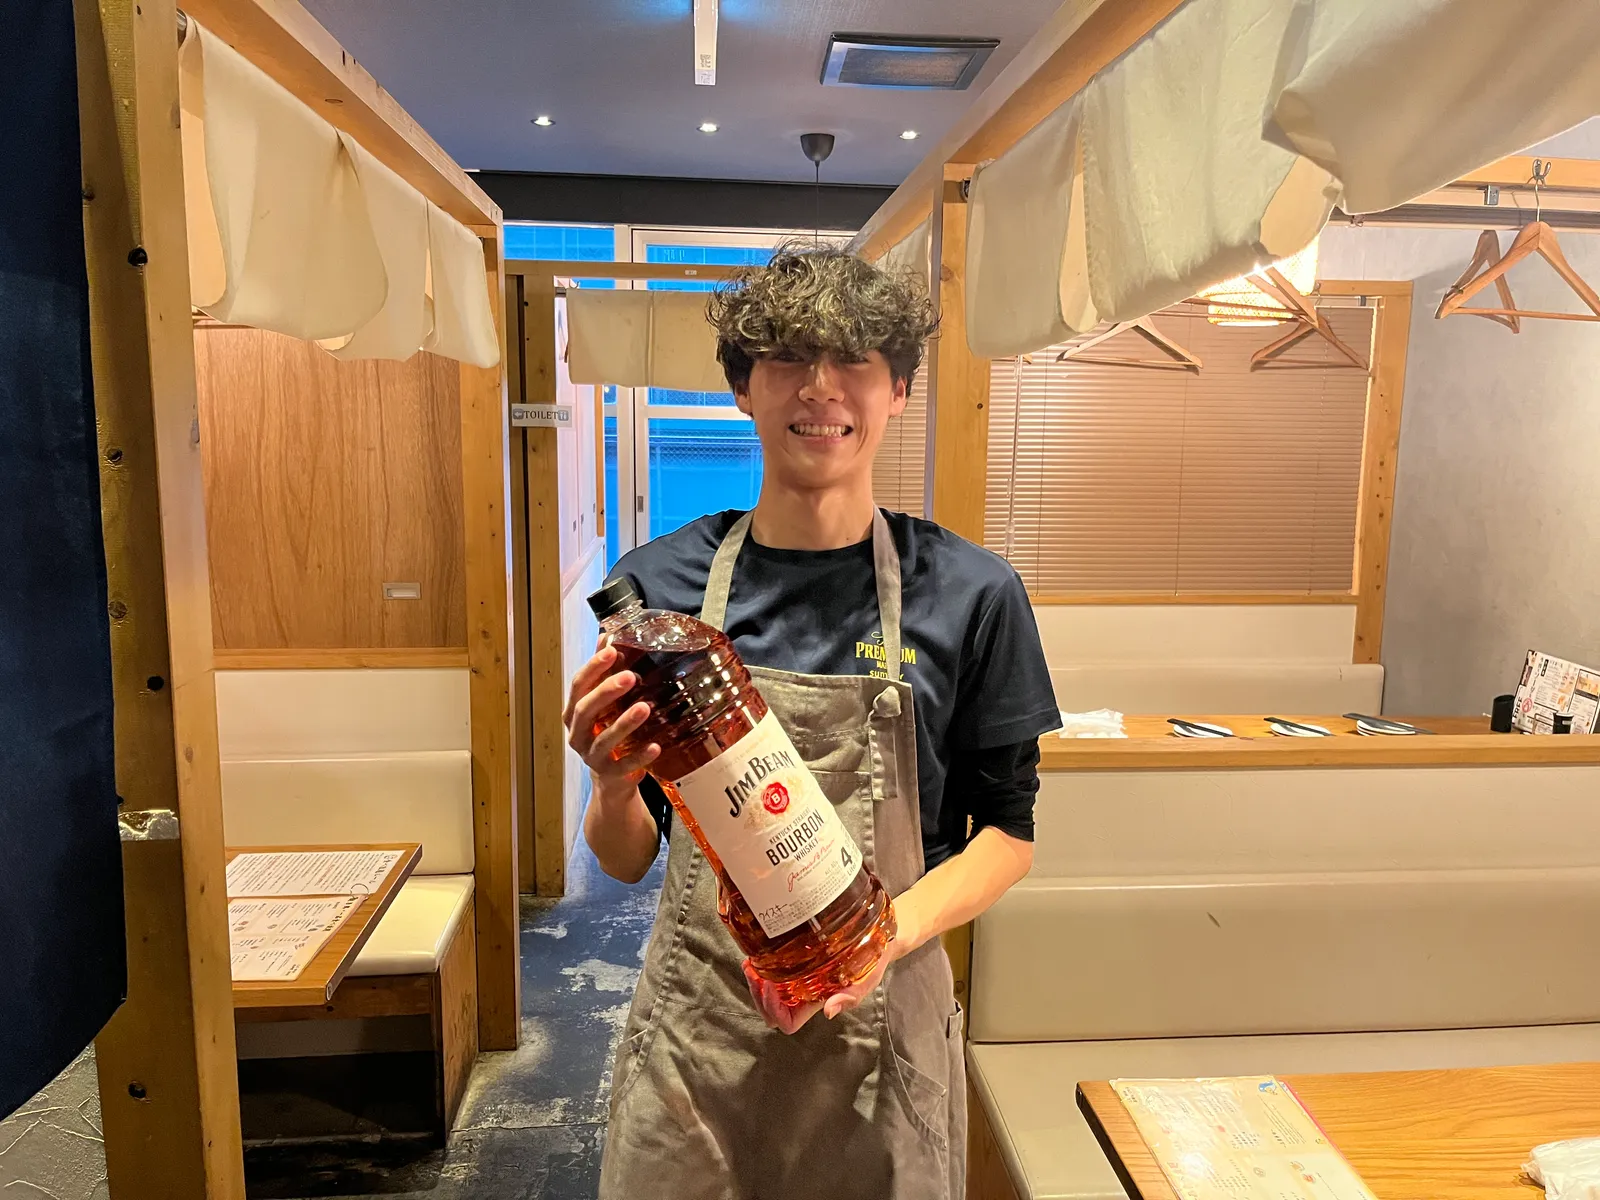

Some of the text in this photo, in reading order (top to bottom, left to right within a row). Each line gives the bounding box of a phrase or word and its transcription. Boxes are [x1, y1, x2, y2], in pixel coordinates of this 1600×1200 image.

[524, 410, 558, 420] TOILET
[771, 793, 781, 804] B
[765, 808, 825, 867] BOURBON
[769, 823, 794, 845] KENTUCKY
[793, 837, 819, 862] WHISKEY
[840, 846, 853, 868] 4
